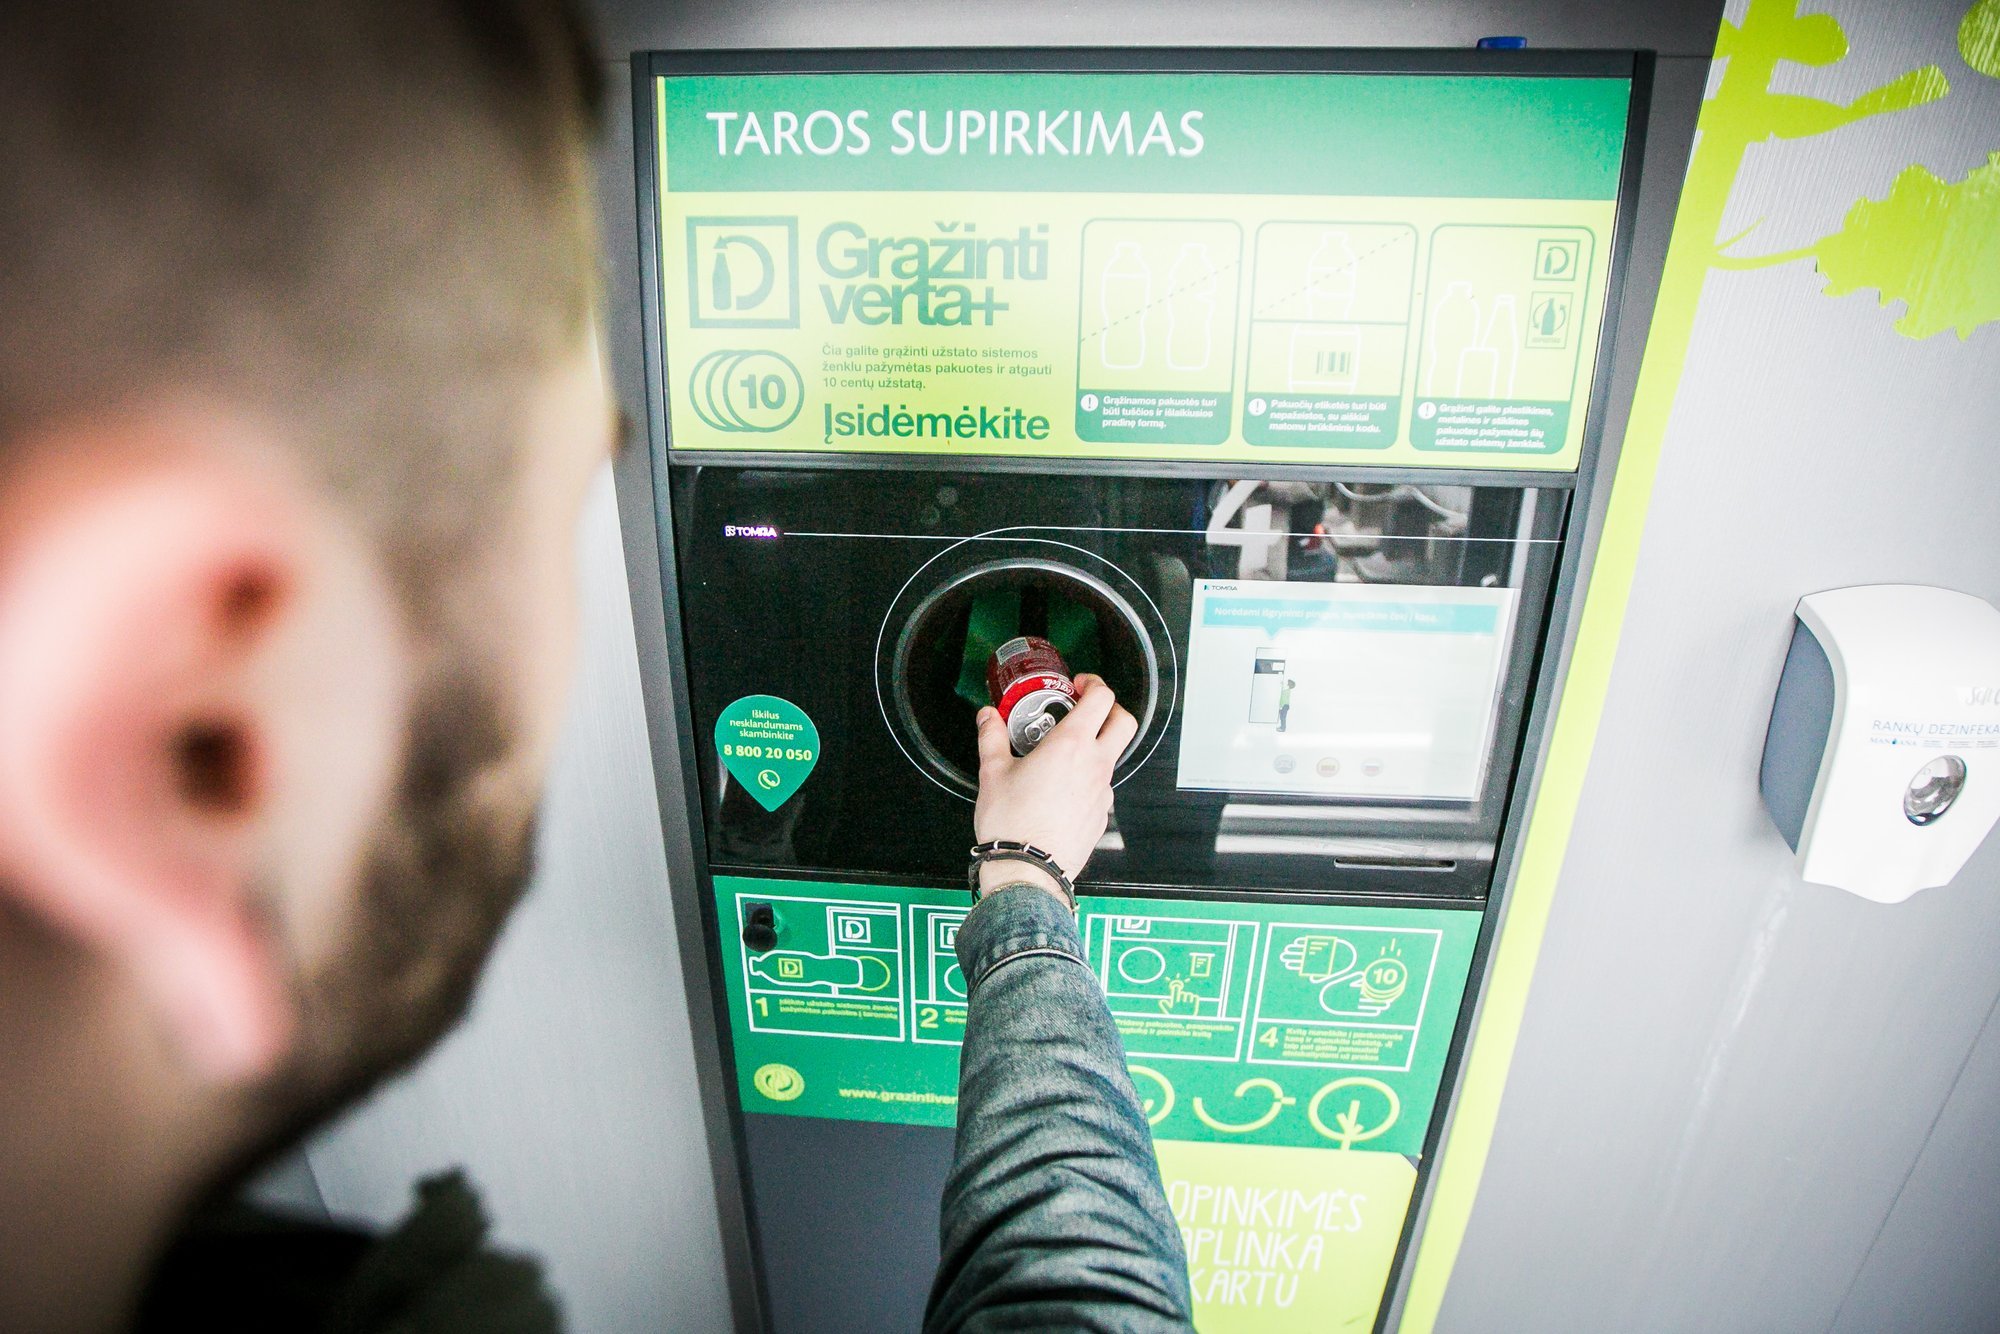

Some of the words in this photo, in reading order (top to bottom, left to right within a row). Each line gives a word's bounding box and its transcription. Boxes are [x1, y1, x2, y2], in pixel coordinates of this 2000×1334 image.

[706, 109, 871, 157] TAROS
[890, 109, 1205, 158] SUPIRKIMAS
[816, 219, 1049, 290] Grąžinti
[822, 344, 842, 356] Čia
[846, 345, 879, 358] galite
[882, 345, 928, 359] grąžinti
[932, 345, 978, 358] užstato
[982, 347, 1039, 359] sistemos
[822, 361, 862, 373] ženklu
[865, 361, 932, 375] pažymėtas
[935, 363, 993, 376] pakuotes
[996, 364, 1006, 375] ir
[1008, 364, 1052, 377] atgauti
[740, 374, 786, 411] 10
[823, 377, 837, 388] 10
[840, 378, 874, 391] centų
[878, 377, 927, 392] užstatą.
[823, 403, 1051, 445] Įsidėmėkite
[736, 526, 777, 538] TOMRA
[1212, 584, 1238, 592] TOMRA
[752, 709, 780, 720] Iškilus
[729, 718, 803, 731] nesklandumams
[1872, 720, 1924, 736] RANKŲ
[739, 728, 794, 741] skambinkite
[724, 744, 733, 756] 8
[735, 745, 762, 759] 800
[765, 747, 783, 760] 20
[786, 748, 812, 761] 050
[1373, 967, 1399, 986] 10
[755, 996, 769, 1018] 1
[920, 1007, 939, 1029] 2
[1259, 1026, 1279, 1049] 4
